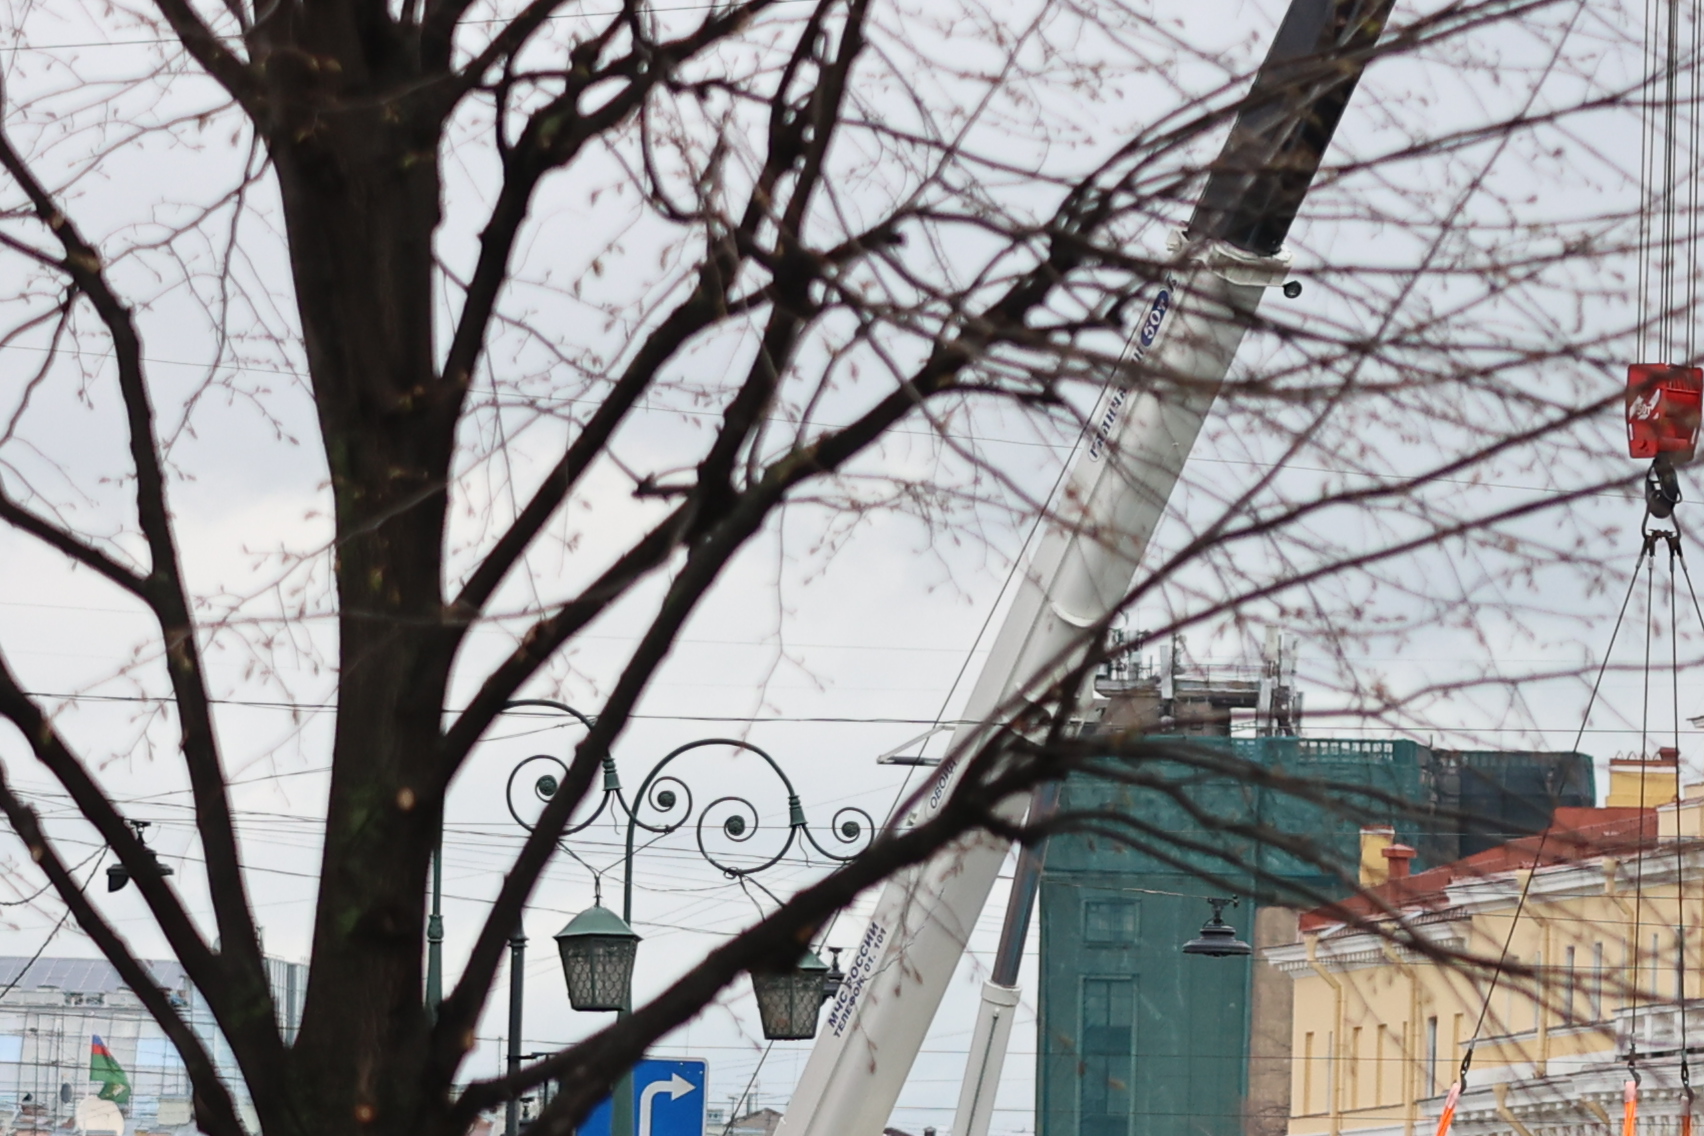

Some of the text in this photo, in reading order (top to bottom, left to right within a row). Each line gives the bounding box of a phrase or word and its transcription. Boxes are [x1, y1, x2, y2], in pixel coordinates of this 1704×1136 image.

[874, 927, 887, 949] 101
[828, 921, 879, 1028] МЧС РОССИИ
